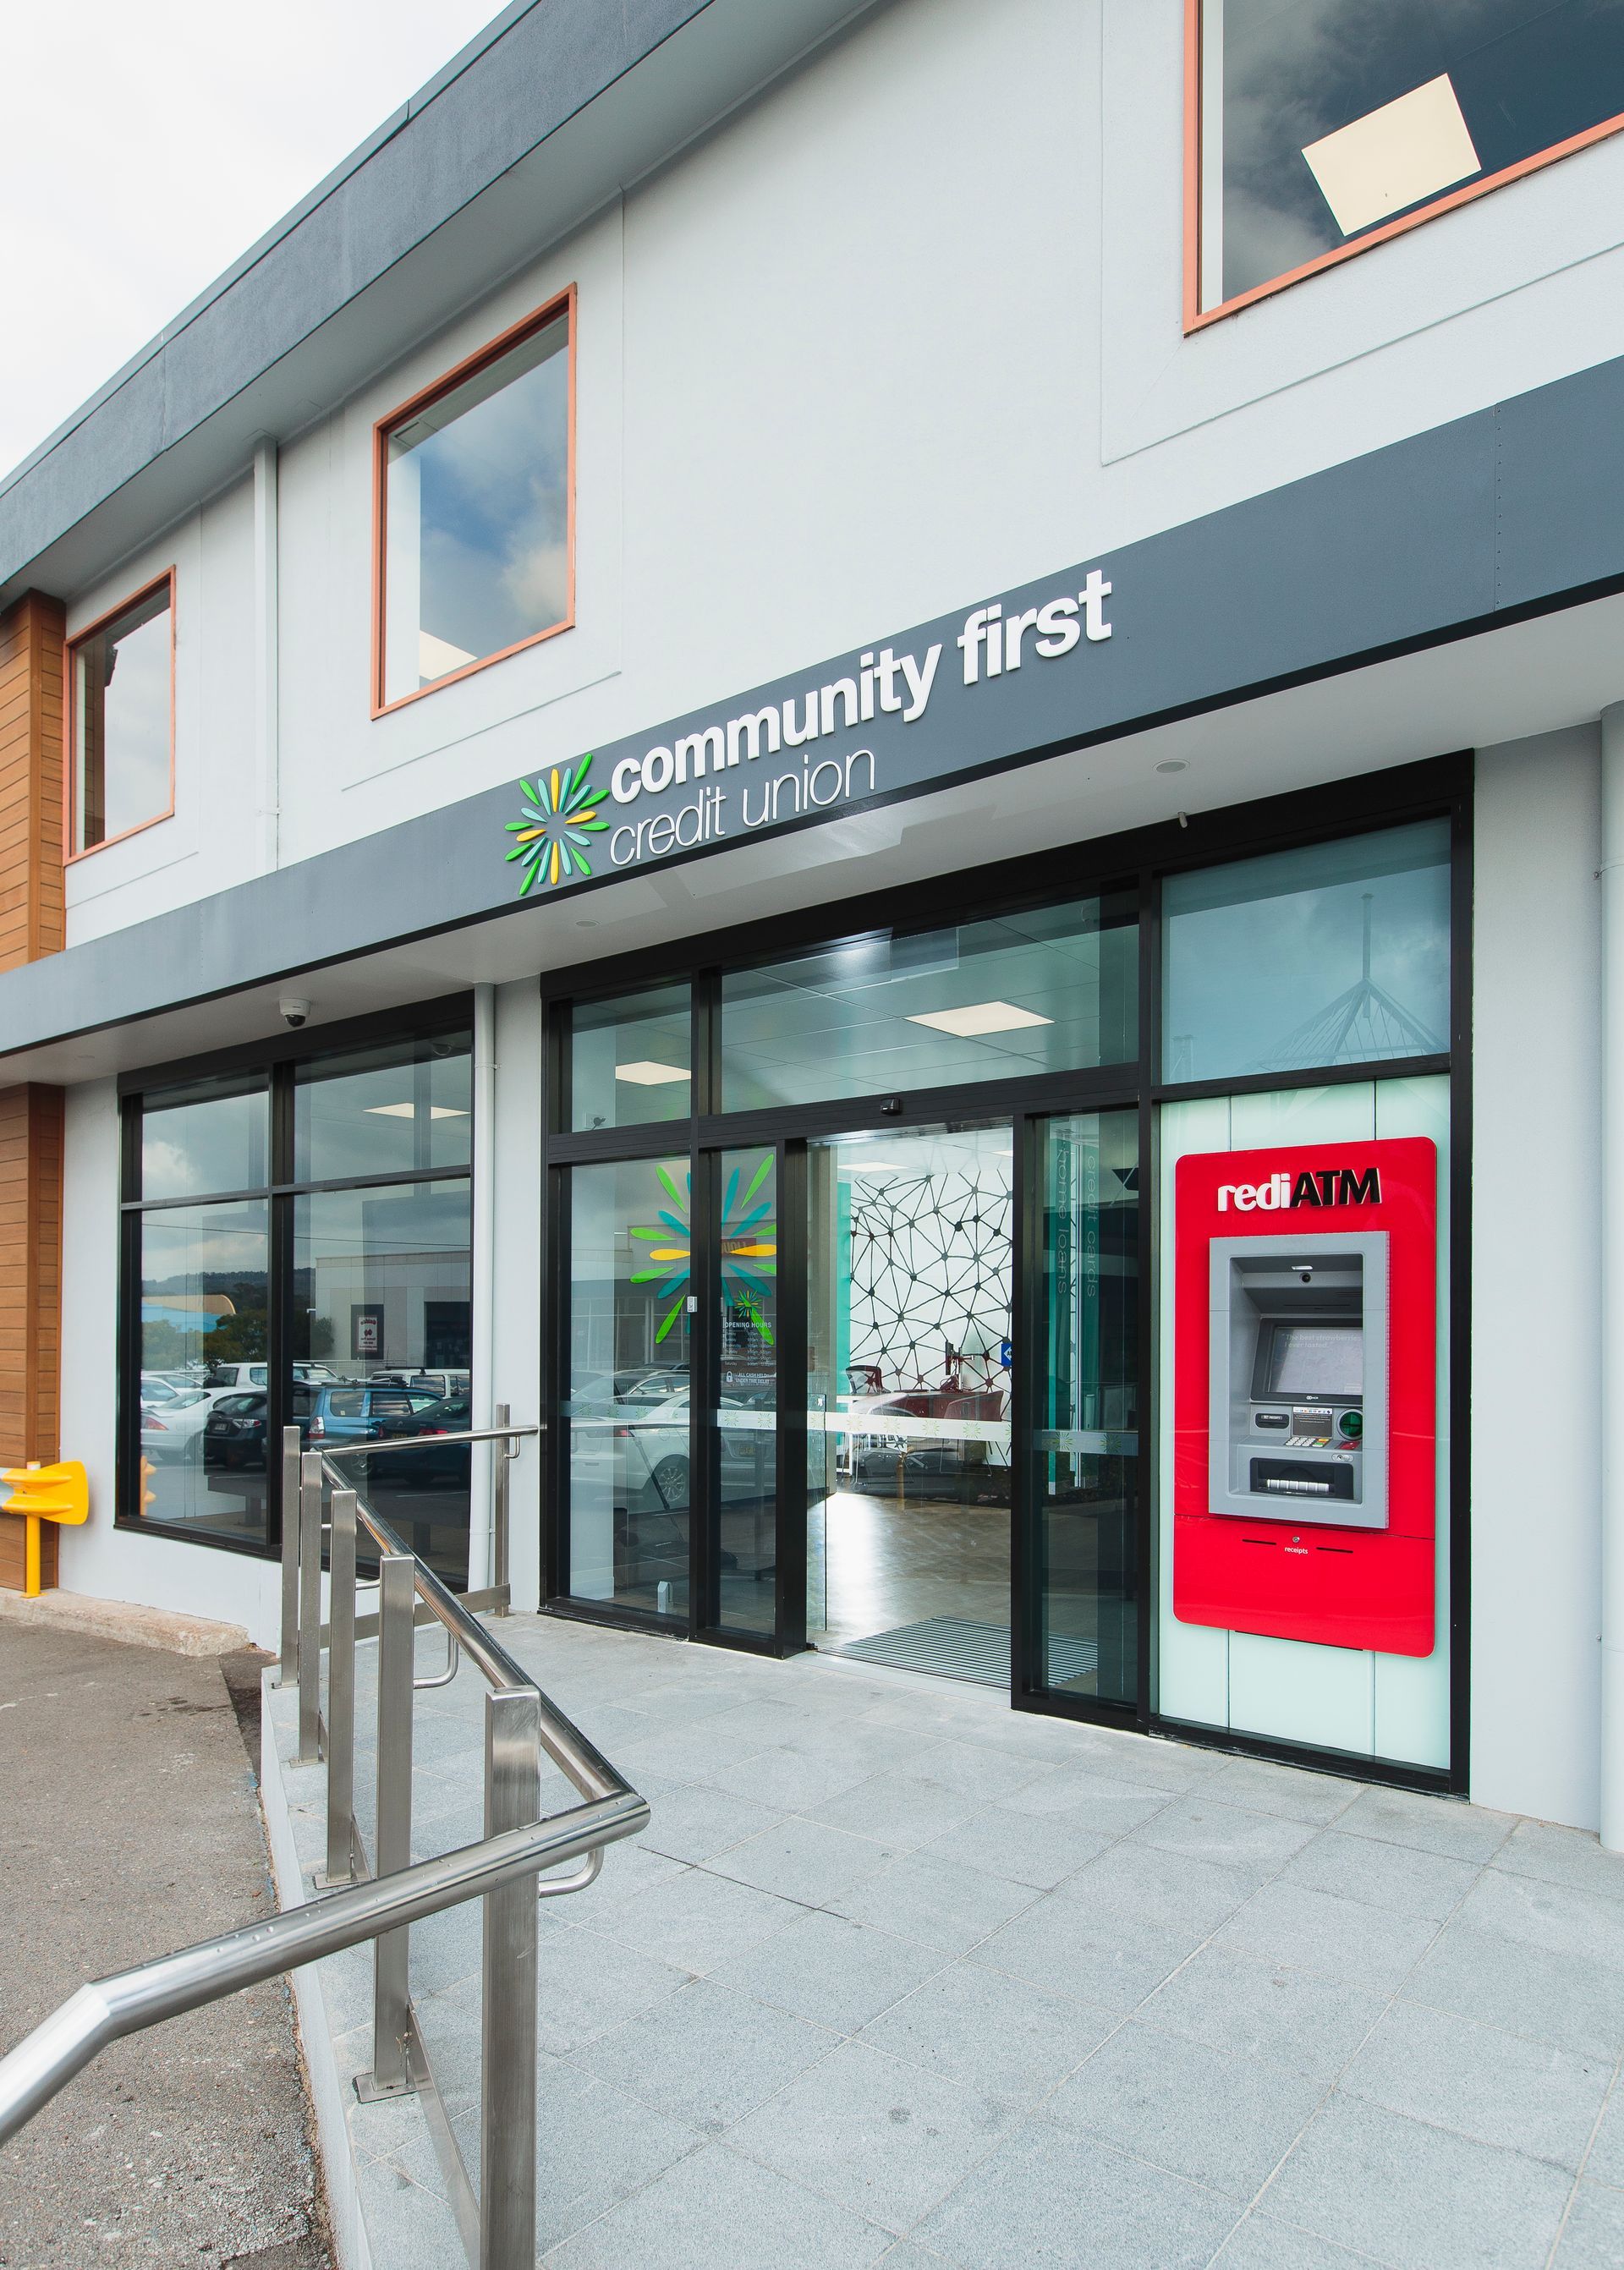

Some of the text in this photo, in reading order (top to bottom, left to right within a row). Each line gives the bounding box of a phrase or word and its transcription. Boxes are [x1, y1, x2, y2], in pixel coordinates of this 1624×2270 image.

[612, 569, 1112, 803] community first
[610, 748, 875, 866] credit union
[1057, 1149, 1070, 1294] home loans
[1087, 1154, 1099, 1297] credit cards
[1217, 1167, 1383, 1212] rediATM
